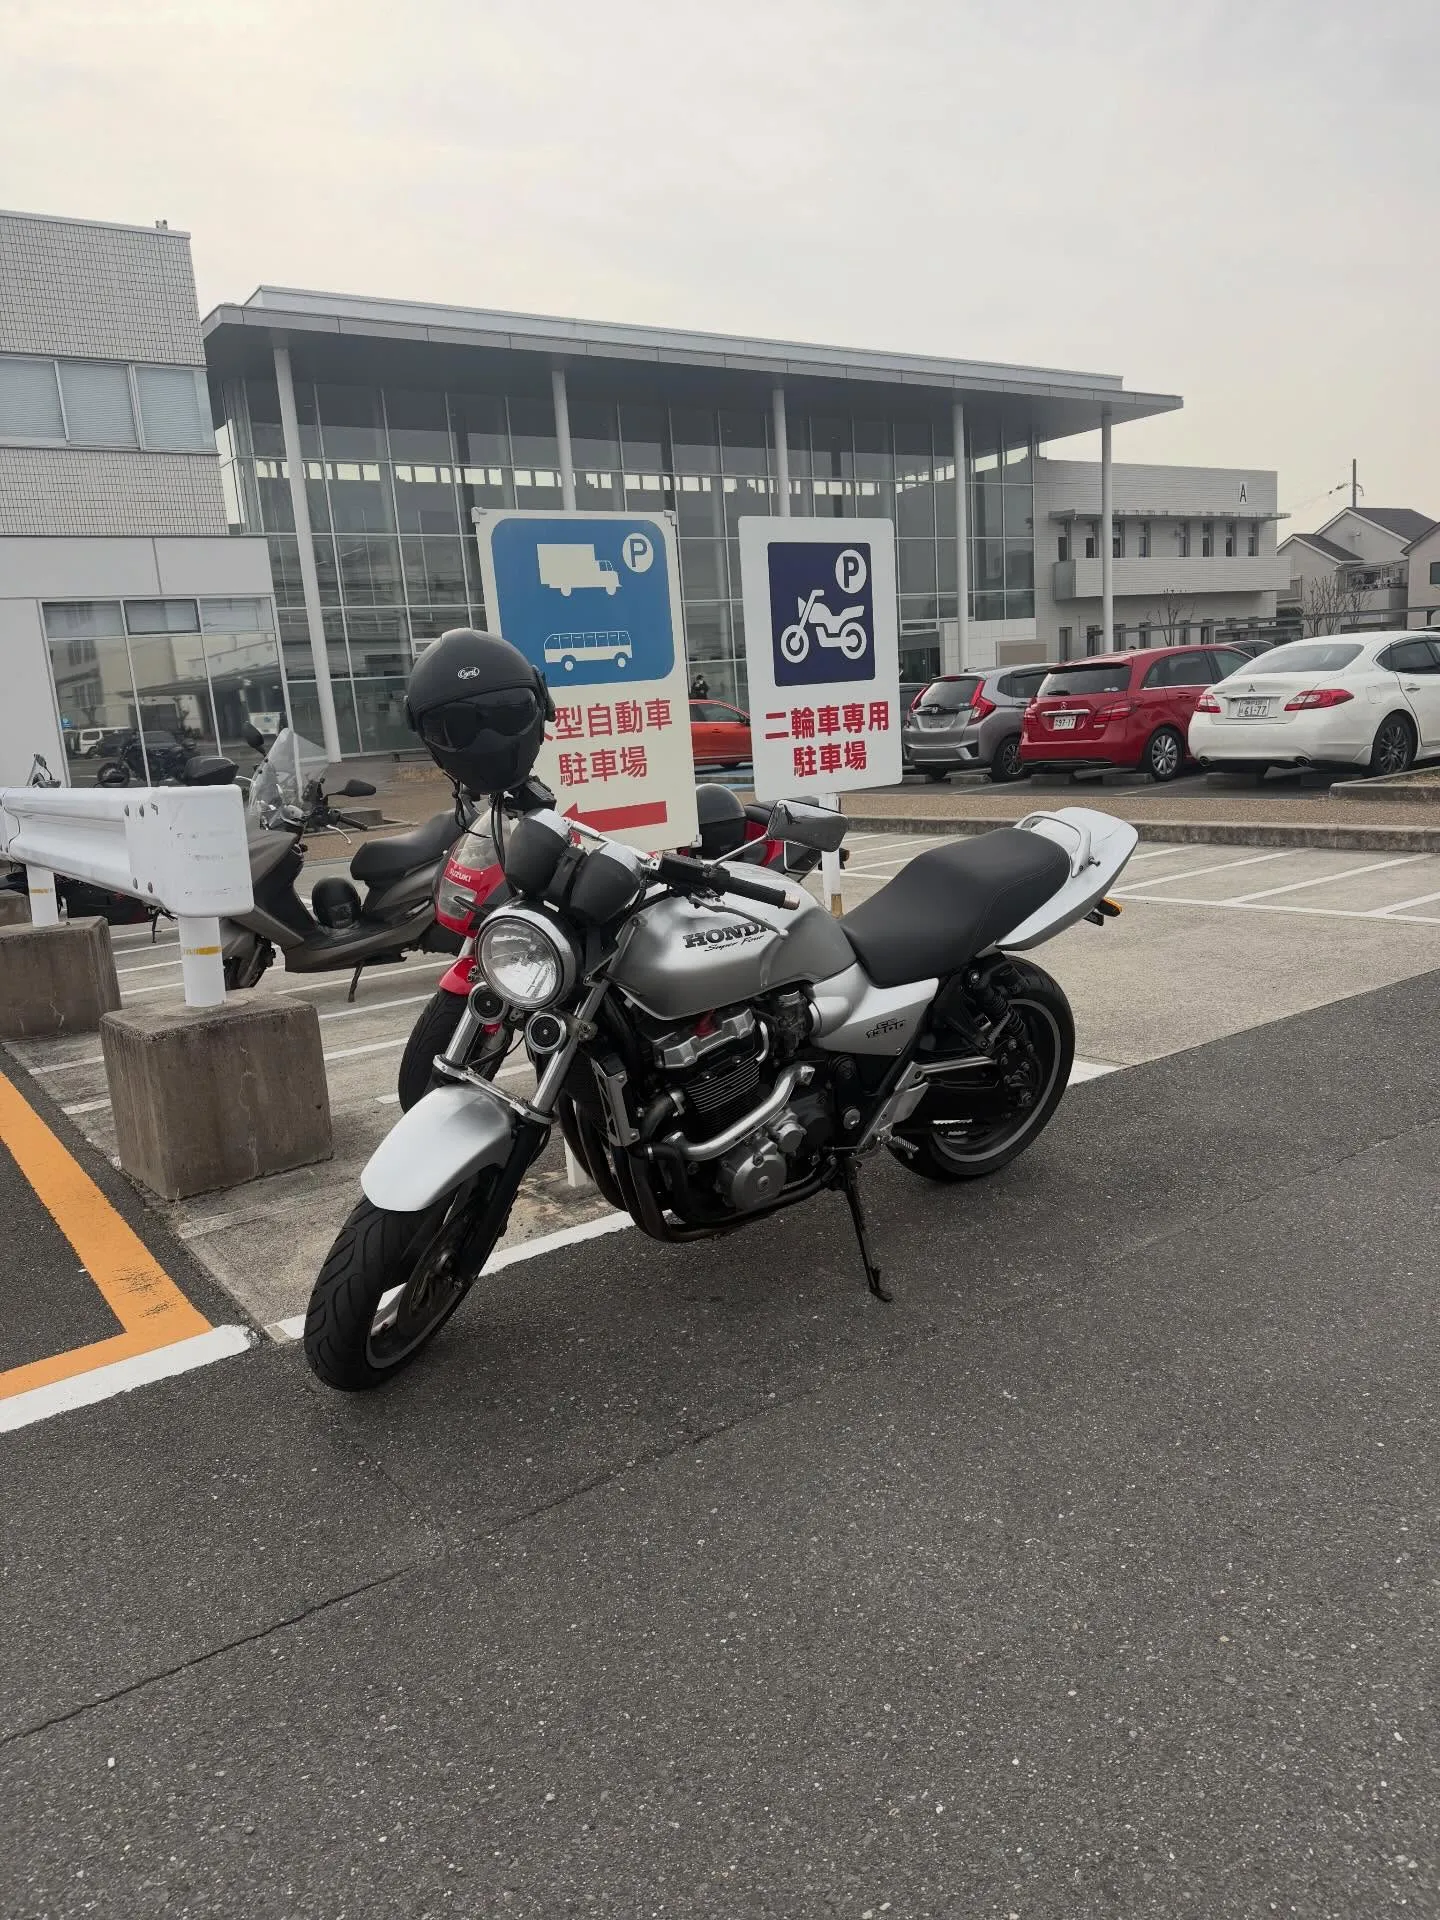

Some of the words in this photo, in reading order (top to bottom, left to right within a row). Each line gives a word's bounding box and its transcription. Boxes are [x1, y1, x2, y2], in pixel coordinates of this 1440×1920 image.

[1240, 483, 1247, 502] A
[629, 538, 648, 568] P
[842, 555, 860, 589] P
[544, 698, 673, 741] 型自動車
[765, 701, 889, 739] 二輪車専用
[558, 746, 648, 786] 駐車場
[793, 740, 867, 777] 駐車場
